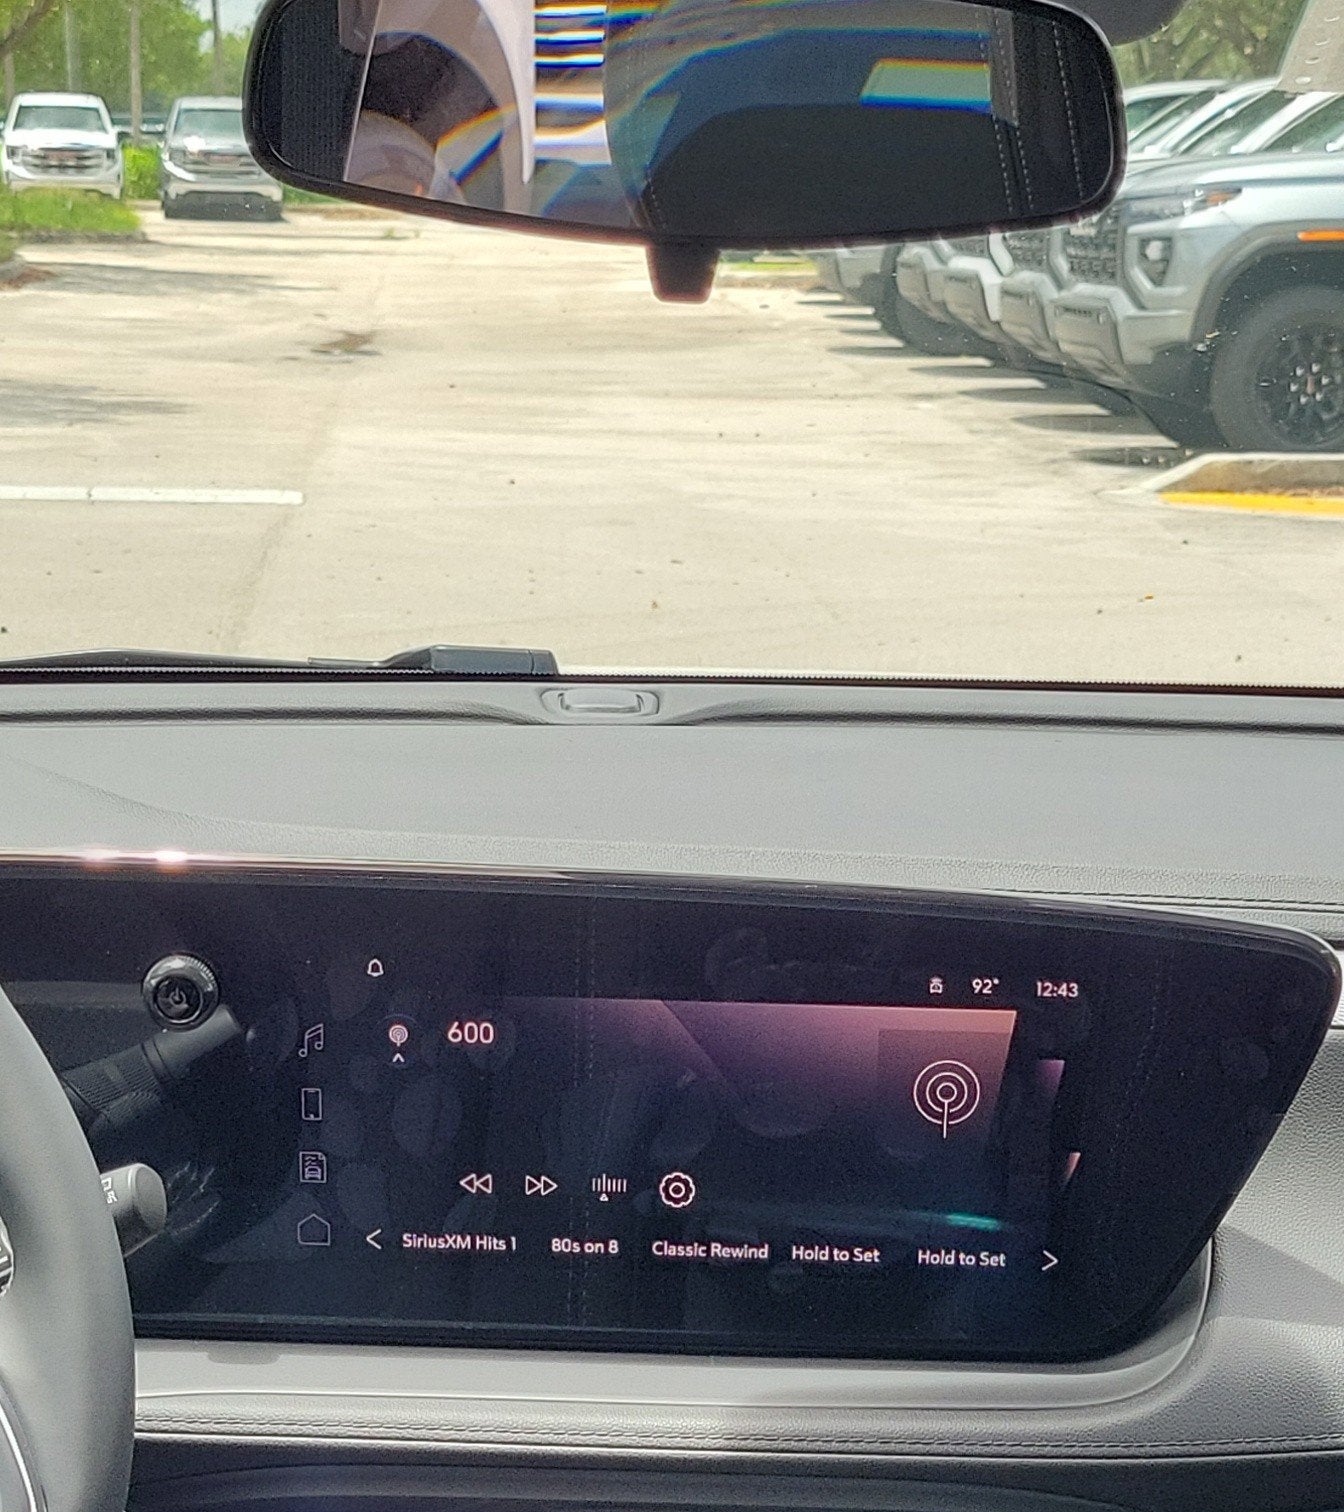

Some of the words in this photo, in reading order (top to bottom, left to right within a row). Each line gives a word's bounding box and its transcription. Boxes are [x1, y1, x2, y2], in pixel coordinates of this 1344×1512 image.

[1036, 981, 1079, 997] 12:43
[447, 1021, 494, 1044] 600
[402, 1233, 472, 1250] SiriusXM
[475, 1235, 506, 1251] Hits
[551, 1238, 581, 1253] 80s
[584, 1241, 605, 1254] on
[608, 1239, 619, 1254] 8
[652, 1241, 707, 1257] Classic
[710, 1242, 769, 1260] Rewind
[792, 1245, 829, 1262] Hold
[833, 1247, 850, 1262] to
[853, 1247, 881, 1263] Set
[917, 1249, 955, 1266] Hold
[958, 1251, 976, 1266] to
[979, 1251, 1006, 1267] Set
